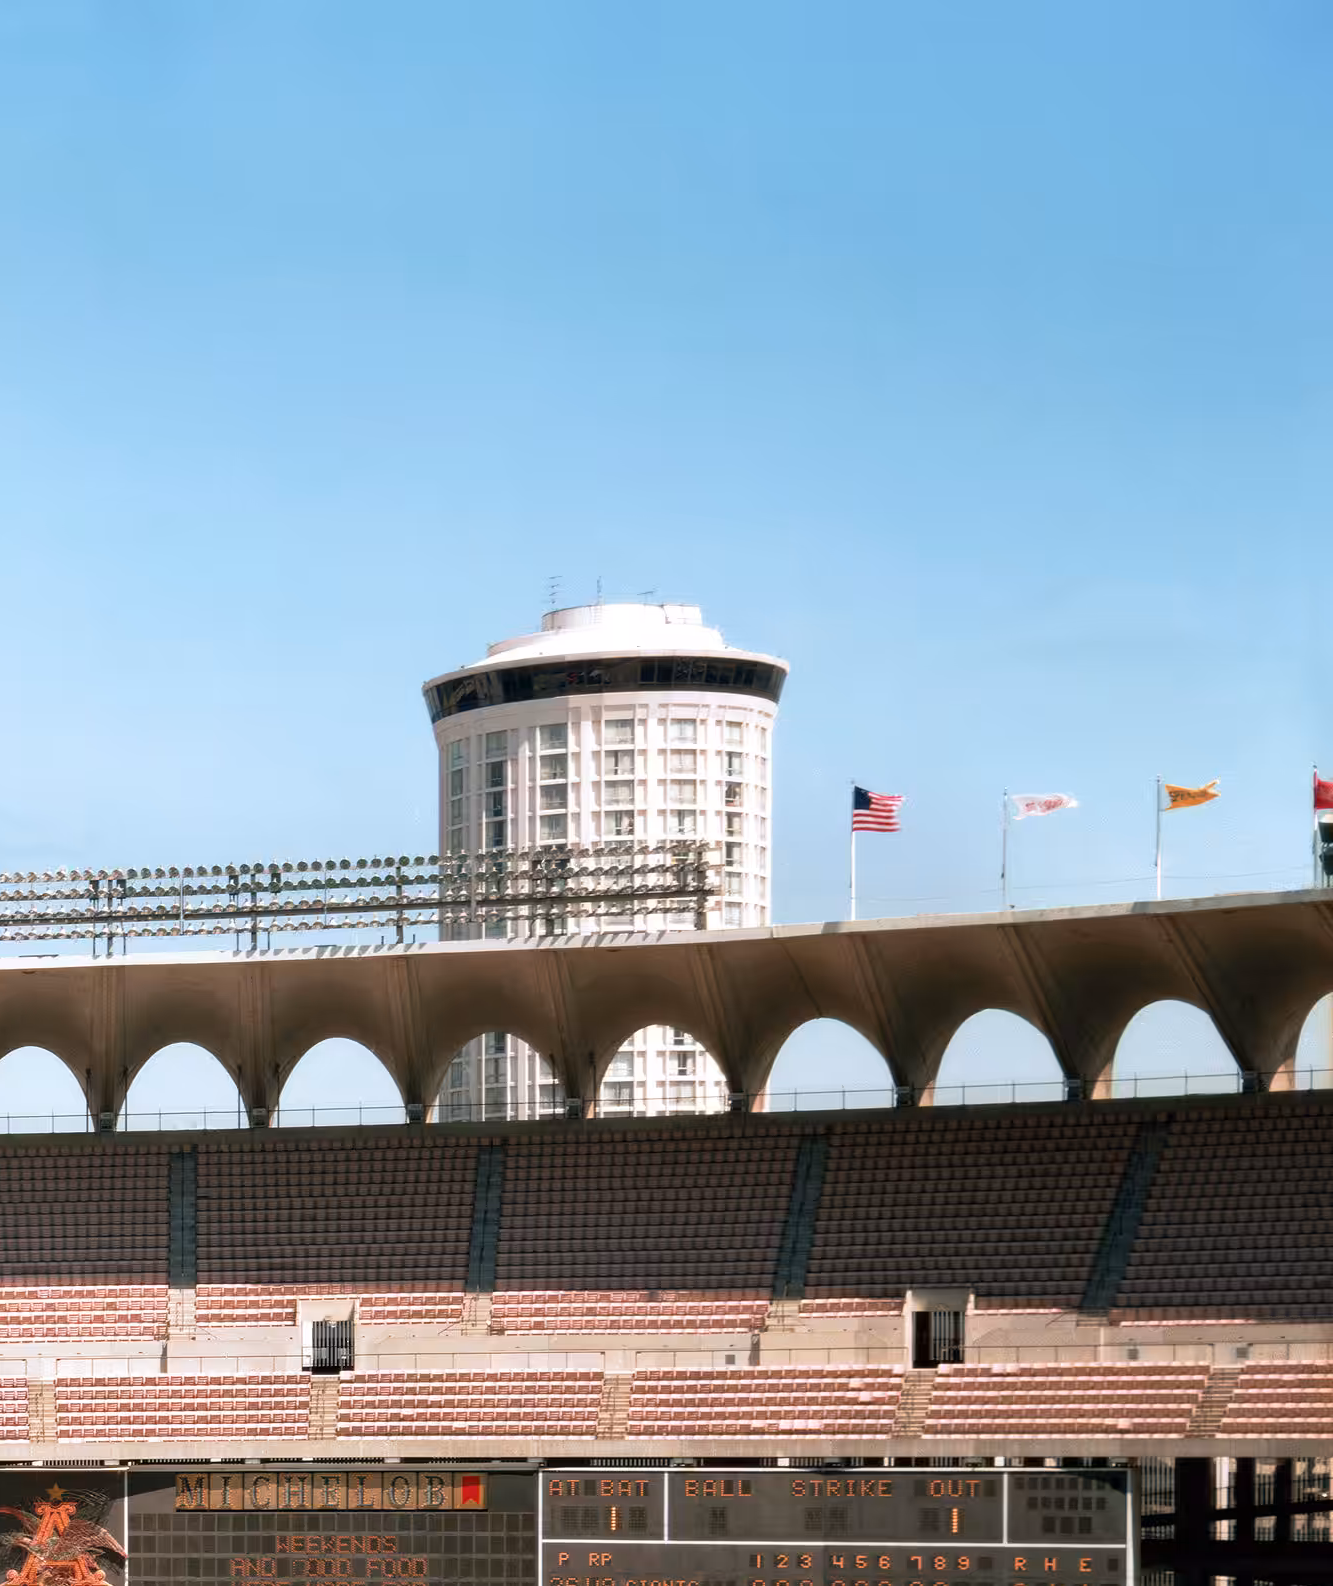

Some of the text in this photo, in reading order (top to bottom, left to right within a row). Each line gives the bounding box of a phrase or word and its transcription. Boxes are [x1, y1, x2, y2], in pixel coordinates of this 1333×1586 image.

[179, 1475, 445, 1508] MICHELOB
[548, 1479, 651, 1496] AT BAT
[685, 1479, 981, 1497] BALL STRIKE OUT
[558, 1552, 569, 1567] P
[588, 1552, 612, 1567] RP
[776, 1555, 789, 1569] 2
[799, 1555, 812, 1569] 3
[832, 1555, 844, 1569] 4
[854, 1555, 868, 1569] 5
[878, 1555, 891, 1570] 6
[910, 1556, 922, 1571] 7
[934, 1556, 946, 1571] 8
[957, 1556, 970, 1571] 9
[1014, 1557, 1027, 1571] R
[1044, 1557, 1057, 1571] H
[1079, 1558, 1092, 1572] E
